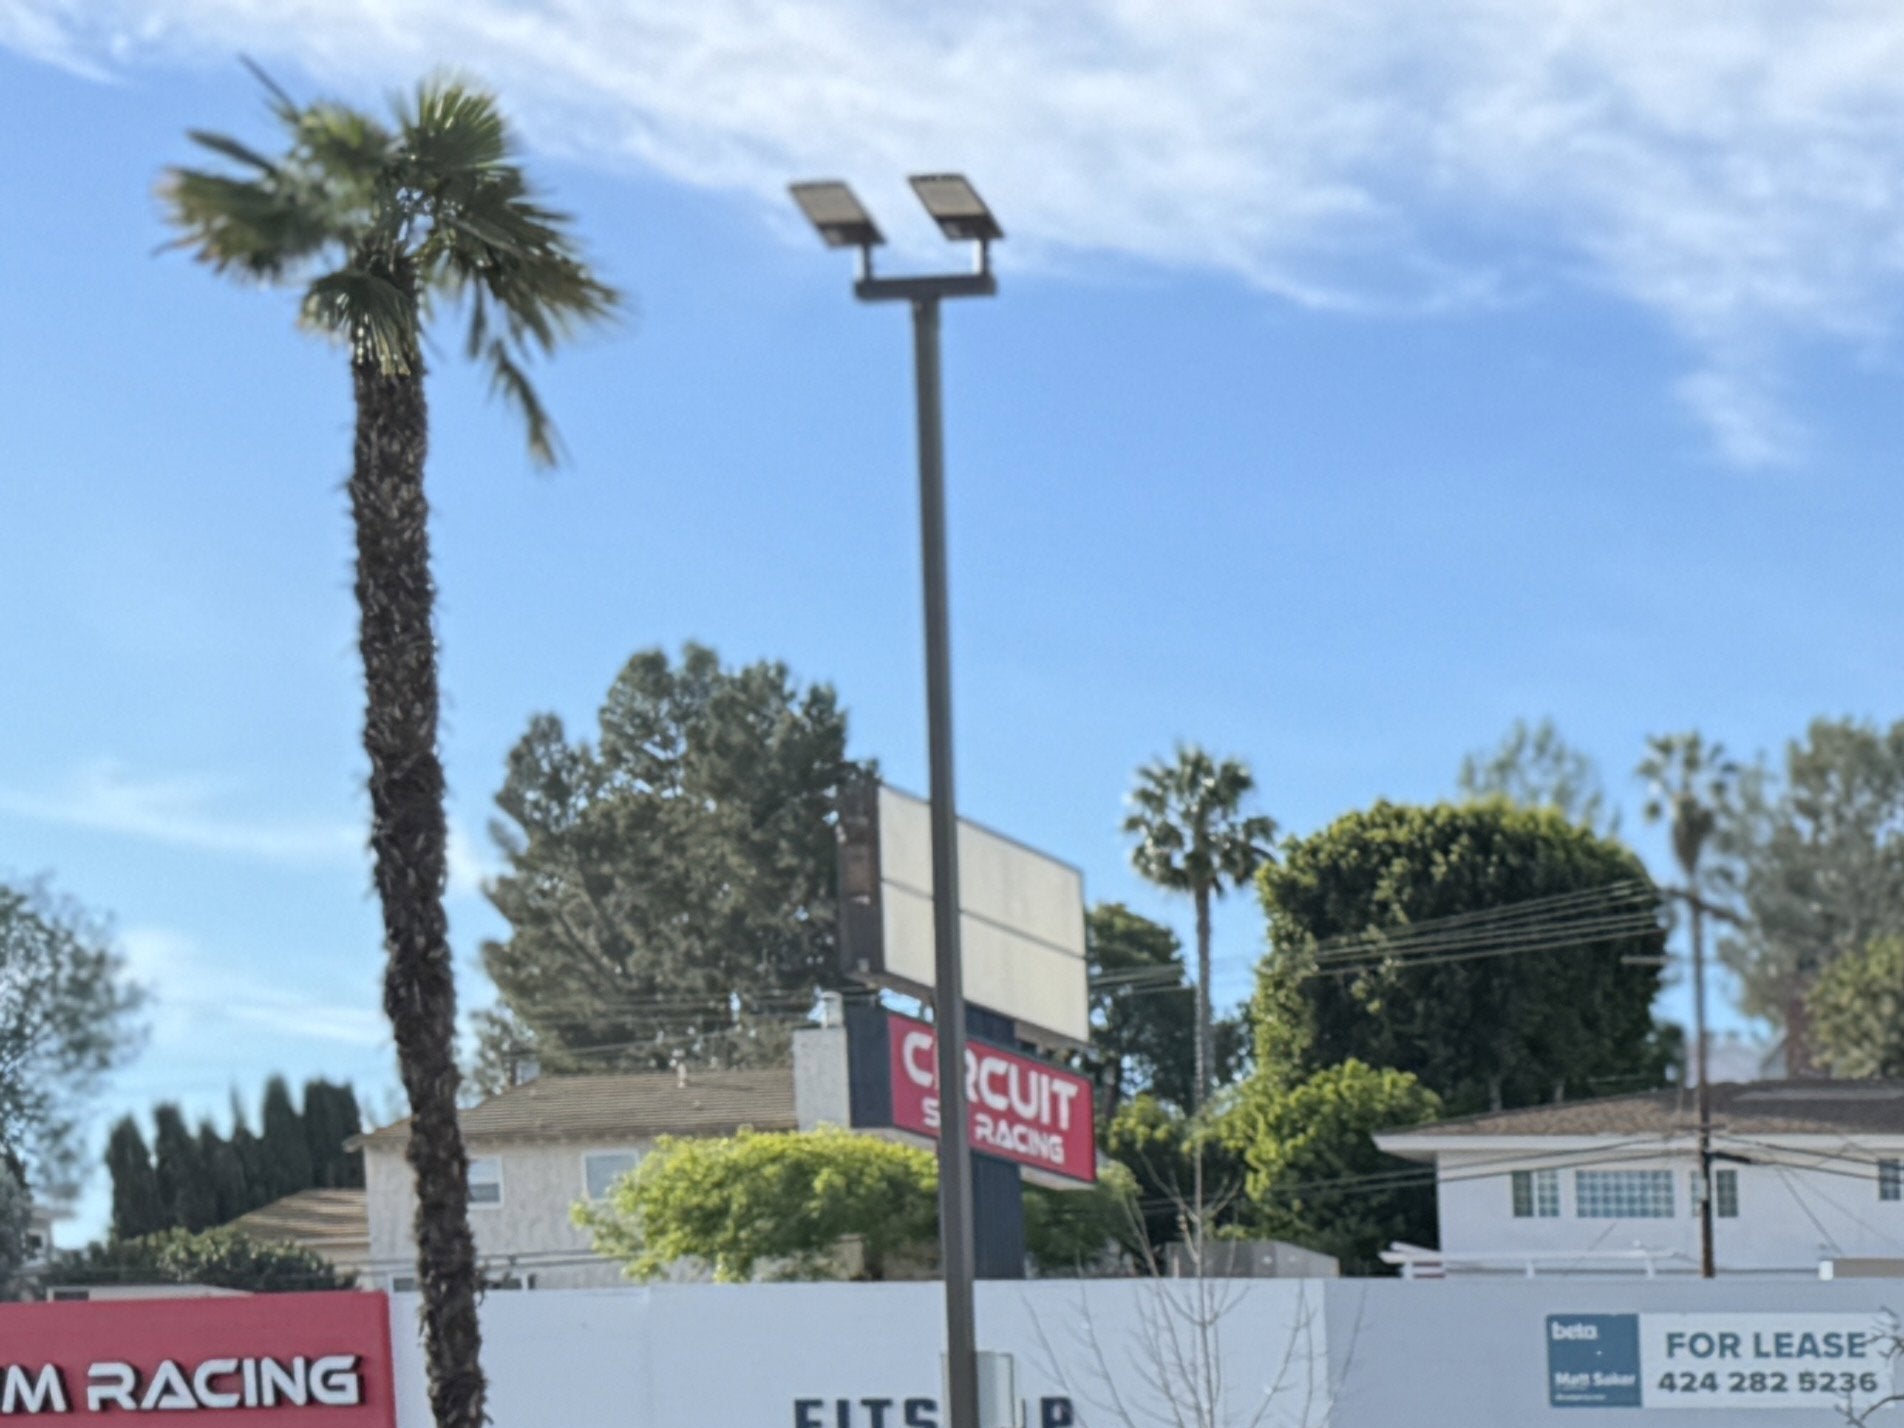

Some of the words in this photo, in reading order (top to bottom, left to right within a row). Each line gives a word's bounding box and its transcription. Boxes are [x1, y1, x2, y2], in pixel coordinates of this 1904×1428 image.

[904, 1031, 1079, 1131] CCUIT
[974, 1112, 1065, 1165] RACING
[1551, 1321, 1599, 1340] beta
[1666, 1331, 1742, 1359] FOR
[1753, 1331, 1867, 1359] LEASE
[87, 1354, 361, 1412] RACING
[1658, 1371, 1719, 1393] 424
[1727, 1371, 1789, 1393] 282
[1797, 1371, 1879, 1394] 5236
